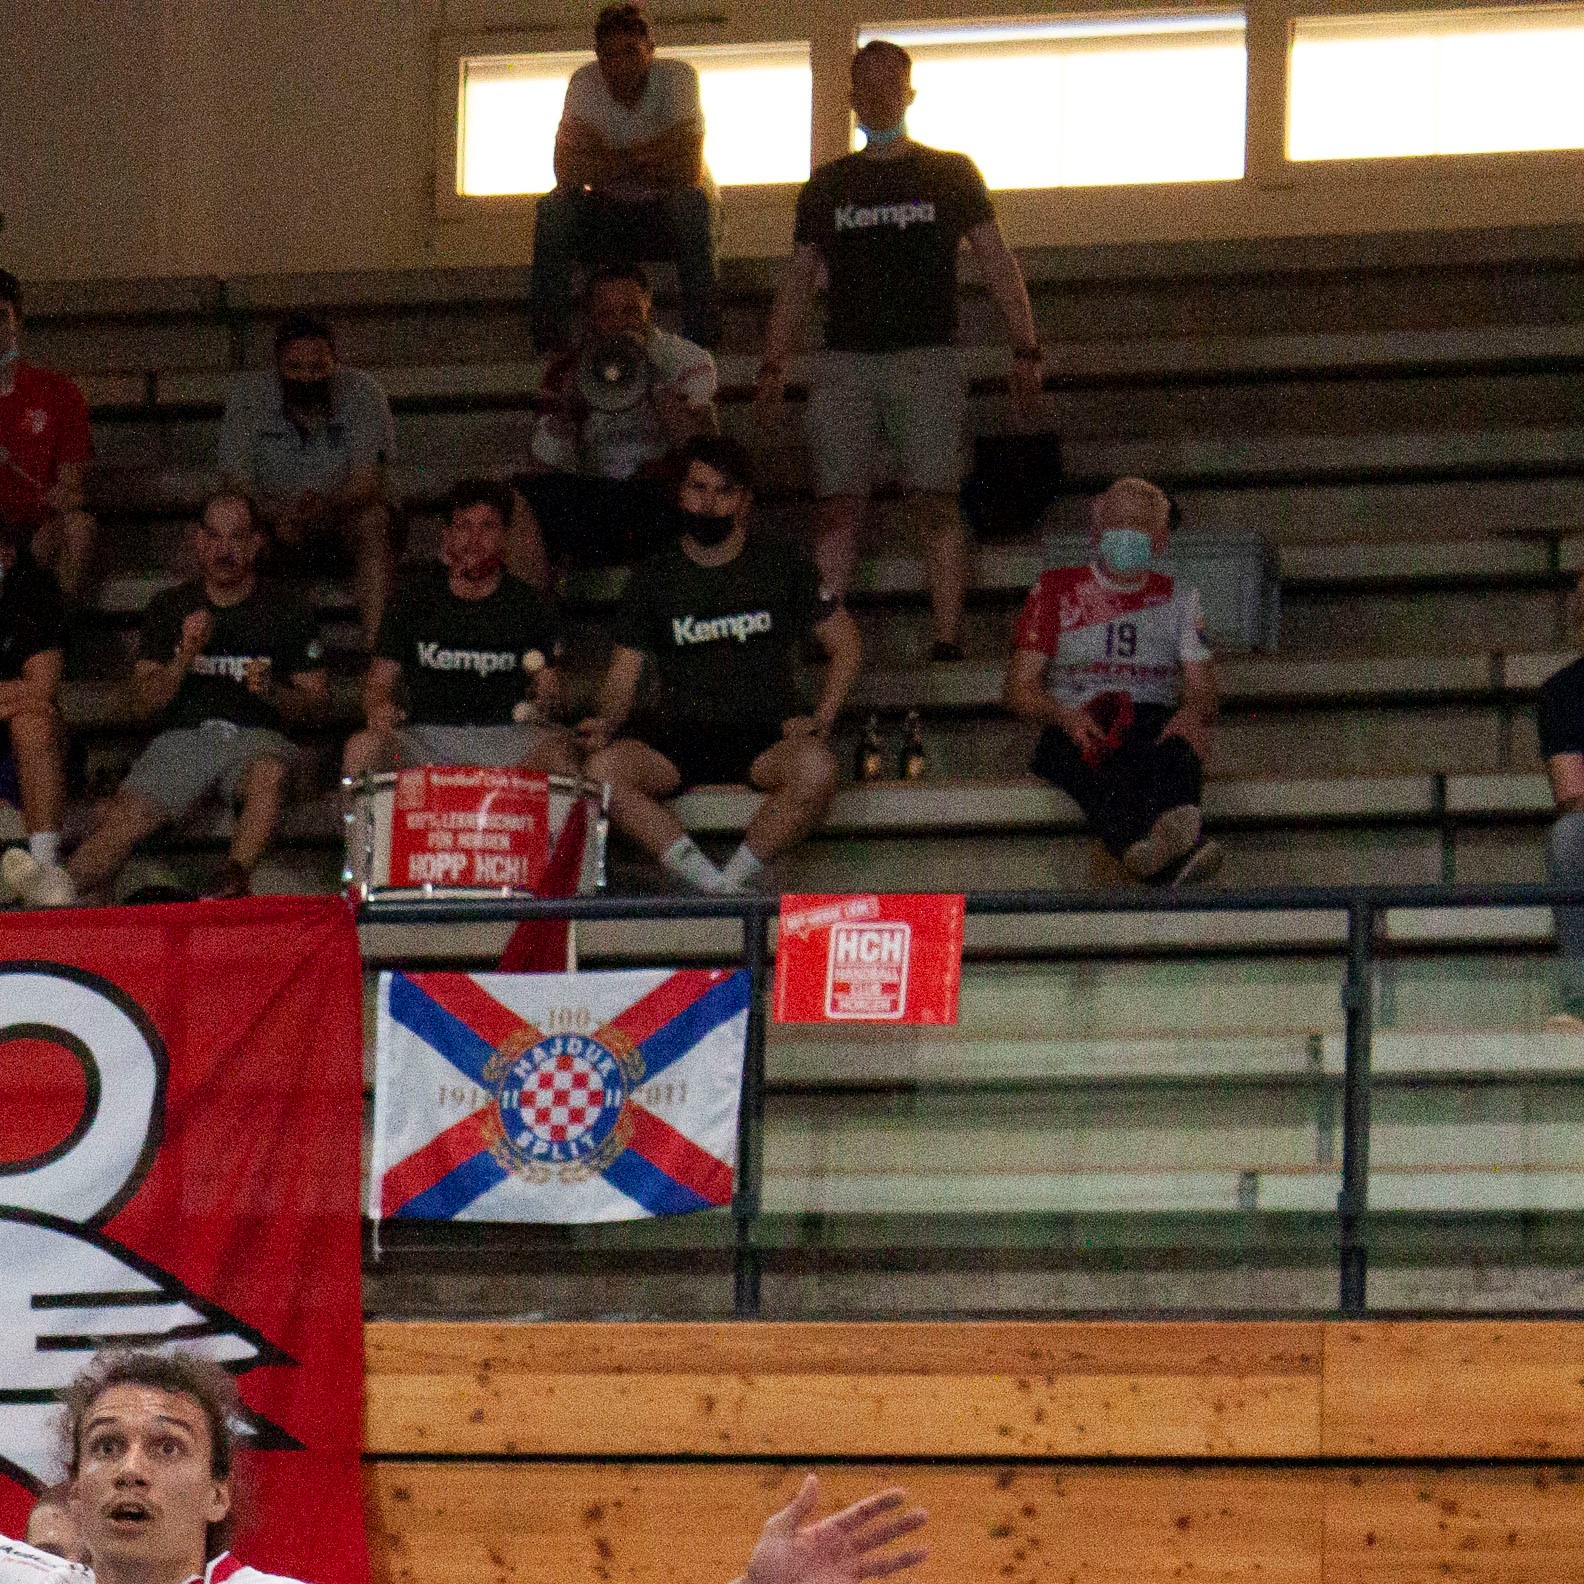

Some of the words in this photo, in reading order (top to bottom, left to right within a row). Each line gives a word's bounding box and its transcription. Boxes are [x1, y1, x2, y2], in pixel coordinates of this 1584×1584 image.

[833, 201, 937, 233] Kempa
[671, 608, 774, 647] Kempa
[1104, 621, 1139, 659] 19
[190, 655, 272, 683] emp
[415, 639, 518, 678] Kempa
[407, 853, 469, 884] HOPP
[836, 931, 903, 962] HCH
[512, 1036, 618, 1080] HAJDUK
[514, 1130, 598, 1160] SPLIT
